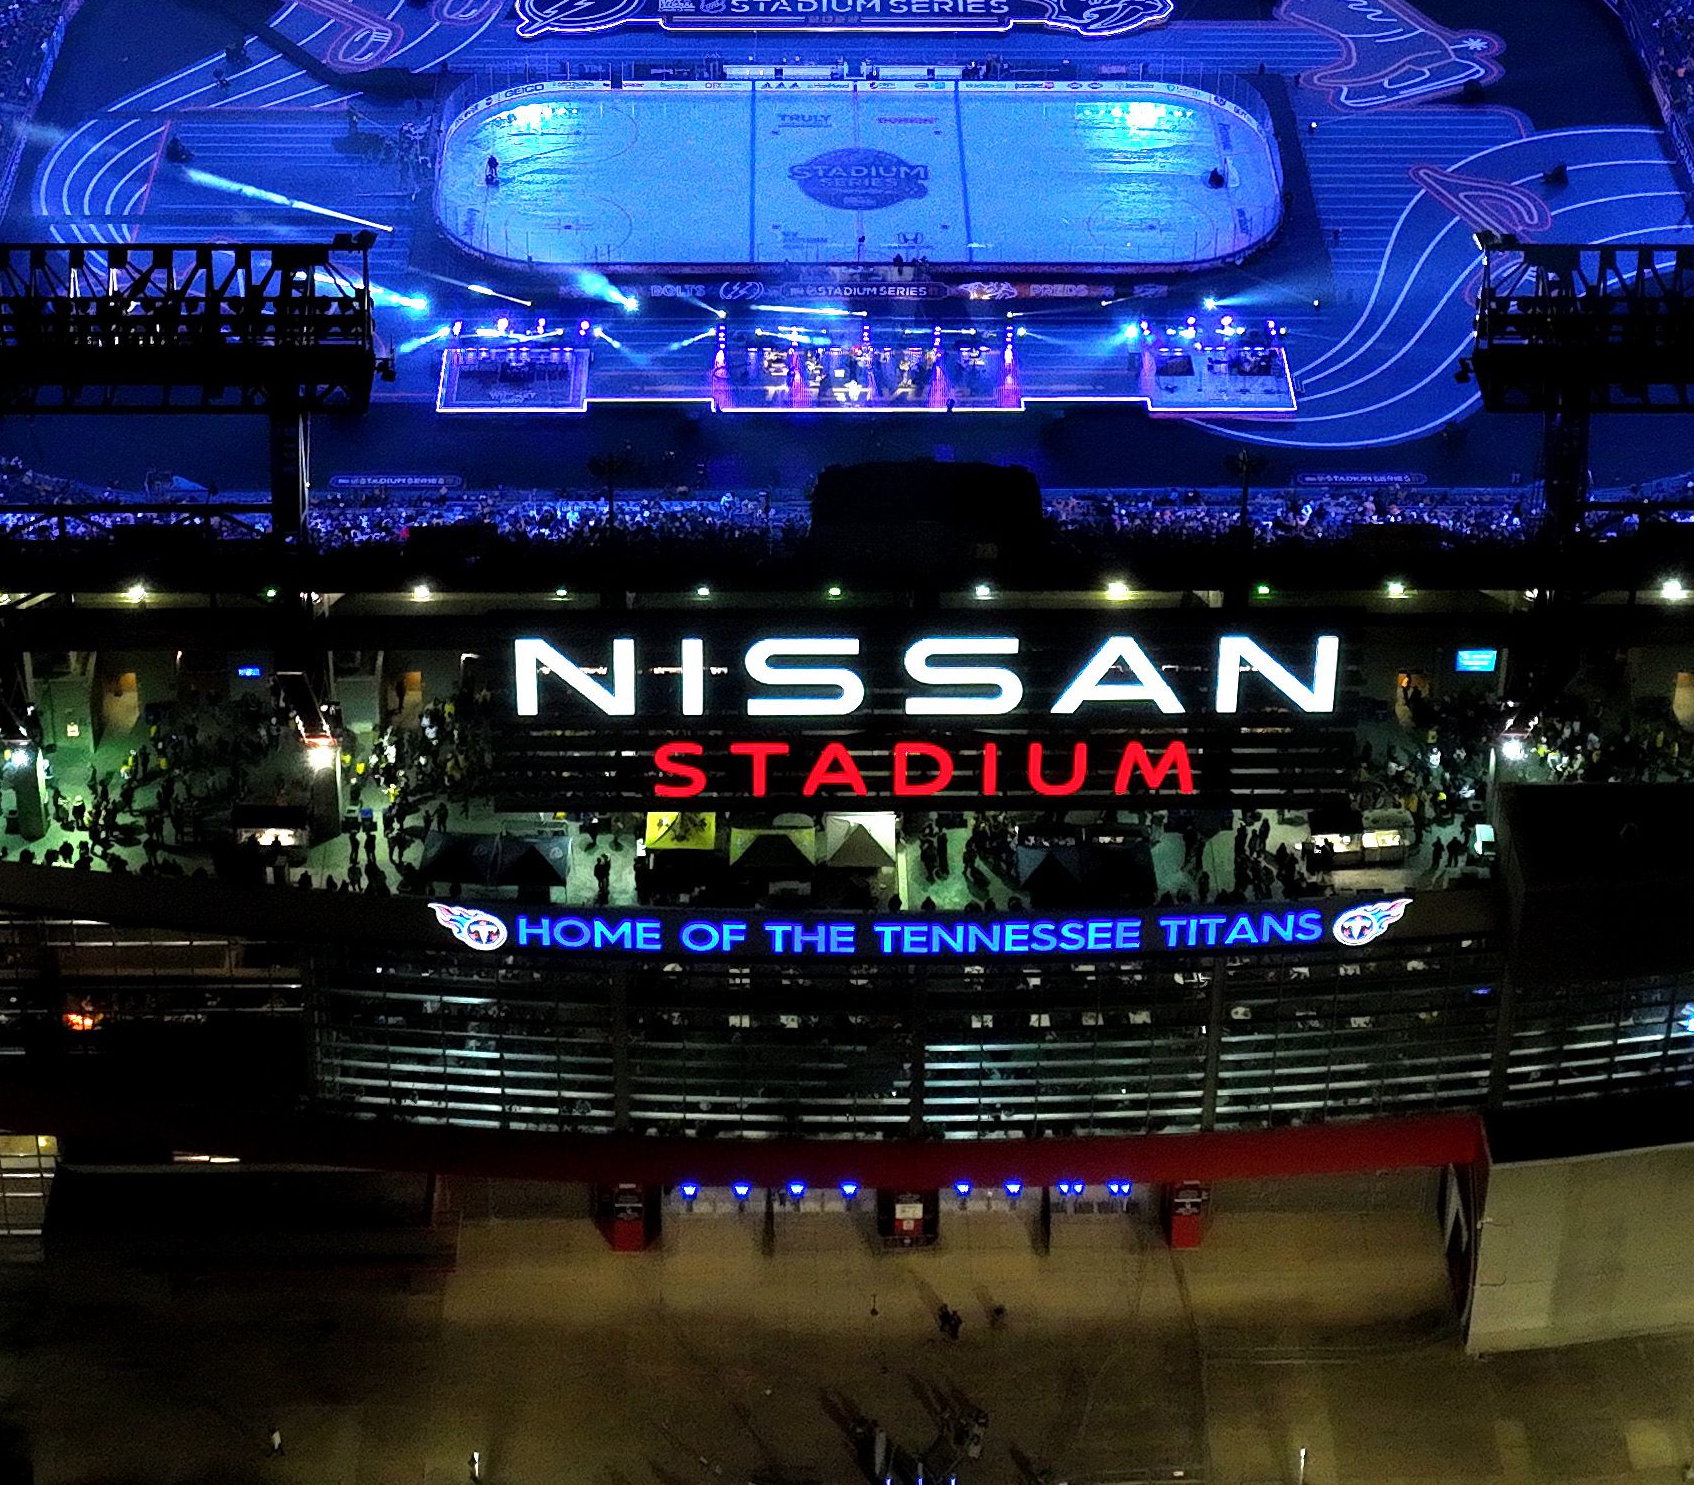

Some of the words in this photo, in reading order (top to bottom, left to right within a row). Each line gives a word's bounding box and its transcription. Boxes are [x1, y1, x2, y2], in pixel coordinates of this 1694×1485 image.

[504, 84, 545, 98] GEICO
[778, 114, 832, 123] TRULY
[790, 165, 927, 180] STADIUM
[820, 178, 898, 187] SERIES
[817, 286, 877, 296] STADIUM
[879, 286, 927, 296] SERIES
[1030, 284, 1089, 297] PREDS
[515, 636, 1338, 715] NISSAN
[655, 741, 1193, 797] STADIUM
[515, 914, 663, 951] HOME
[679, 919, 748, 953] OF
[762, 920, 857, 955] THE
[872, 917, 1142, 955] TENNESSEE
[1158, 908, 1324, 949] TITANS
